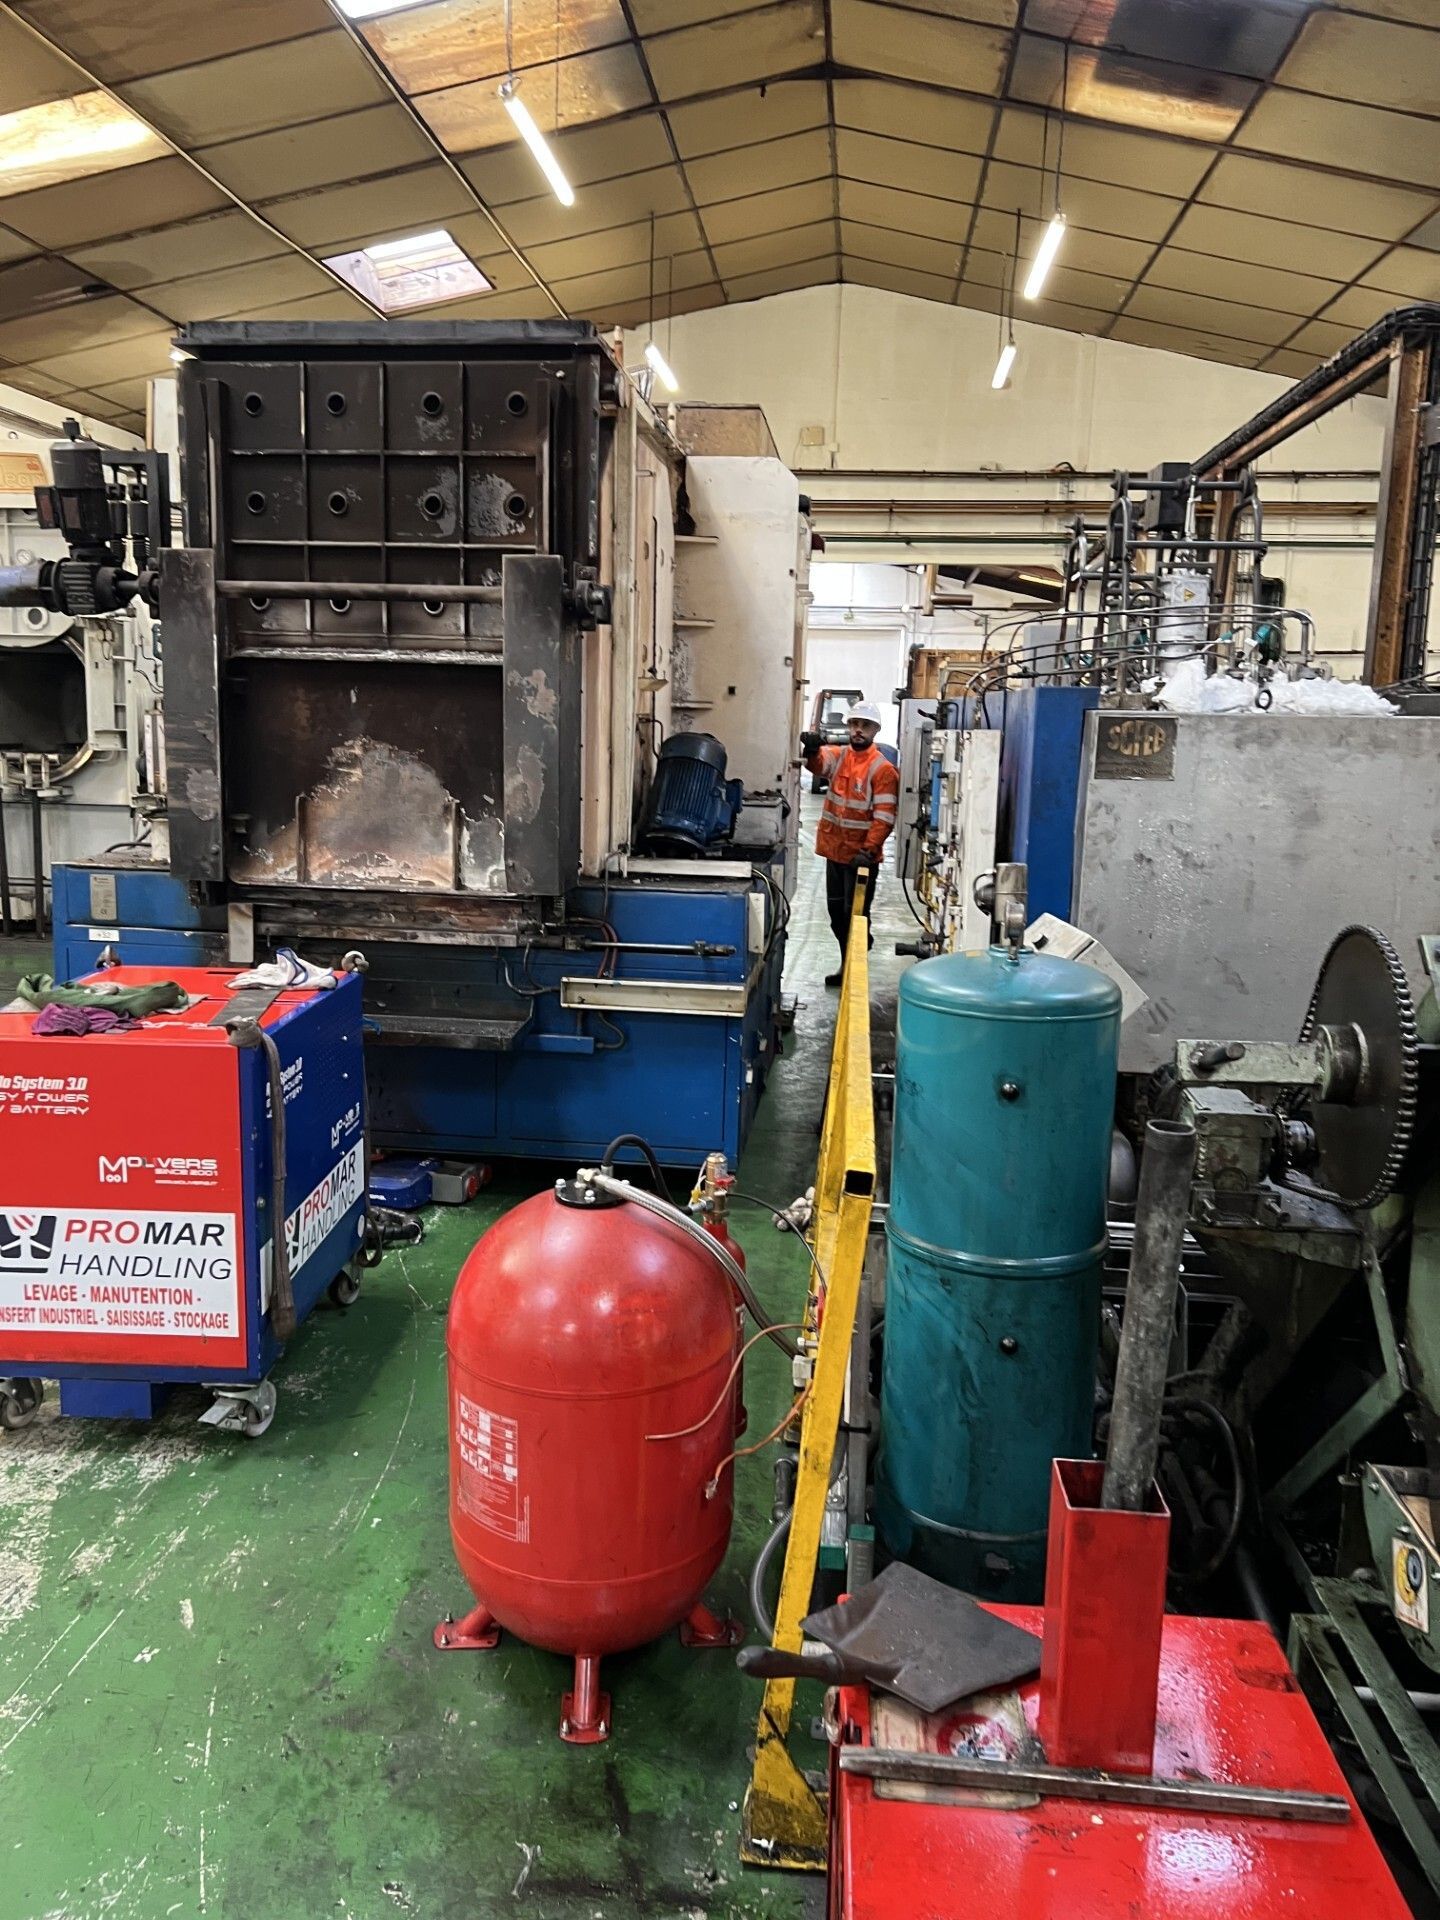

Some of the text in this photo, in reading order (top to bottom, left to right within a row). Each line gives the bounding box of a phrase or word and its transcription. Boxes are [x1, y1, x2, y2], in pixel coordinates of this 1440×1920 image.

[12, 1075, 64, 1091] System
[65, 1076, 88, 1091] 3.0
[10, 1104, 90, 1115] BATTERY
[190, 1168, 218, 1177] 2001
[303, 1151, 356, 1230] PROMAR
[301, 1180, 355, 1262] HANDLING
[64, 1218, 225, 1247] PROMAR
[59, 1253, 232, 1281] HANDLING
[24, 1284, 193, 1306] LEVAGE MANUTENTION
[39, 1308, 98, 1326] INDUSTRIEL
[107, 1310, 165, 1328] SAISISSAGE
[174, 1311, 229, 1330] STOCKAGE
